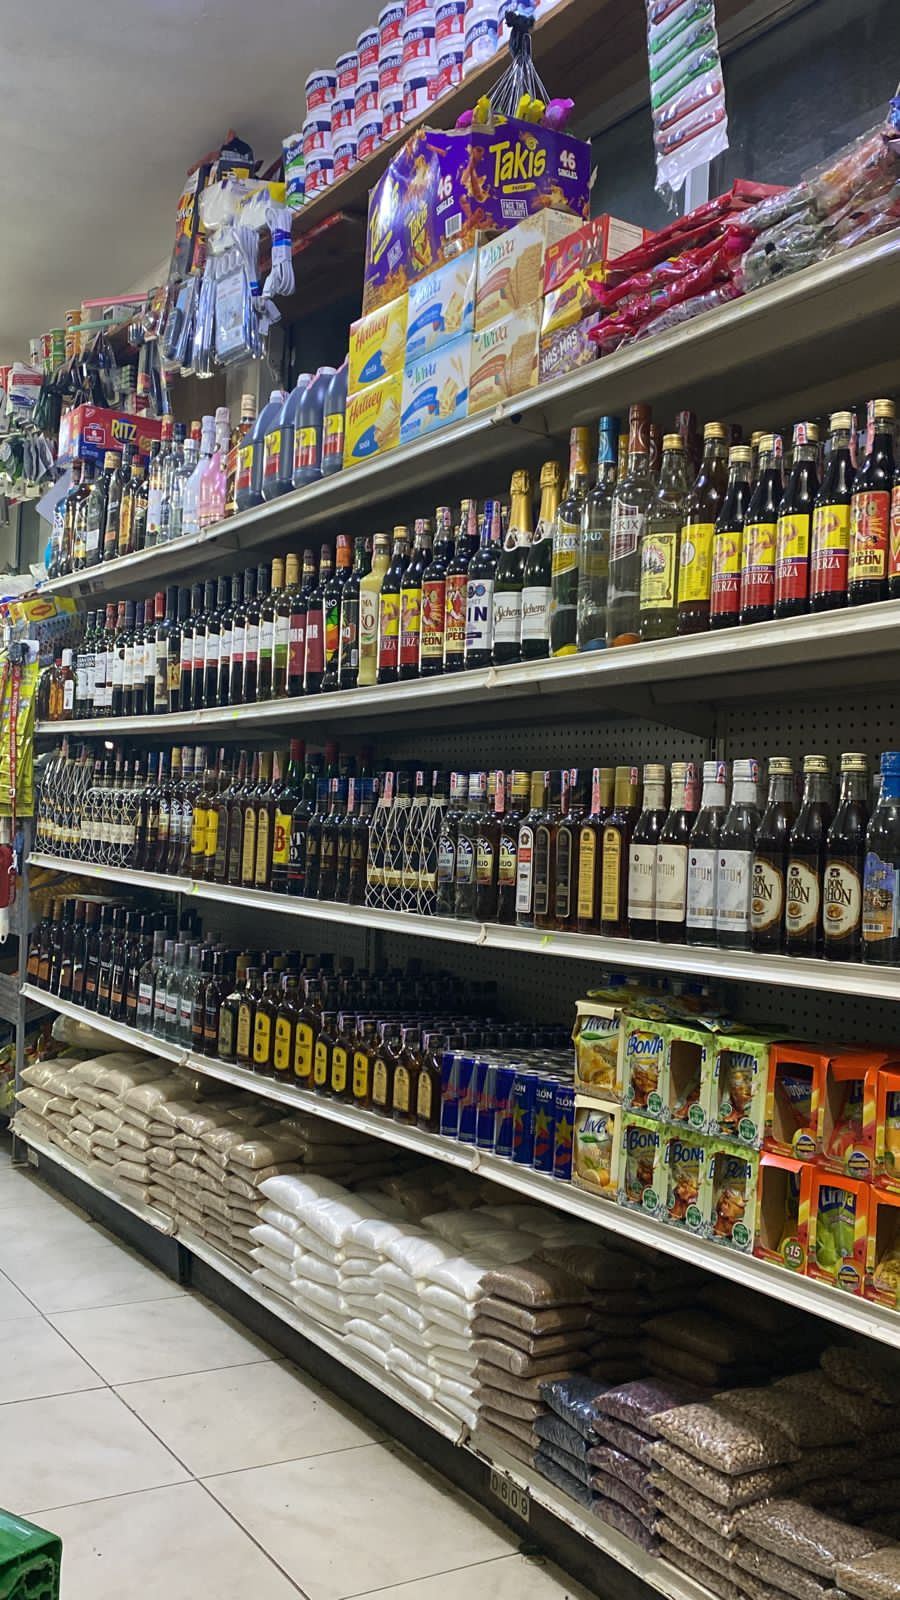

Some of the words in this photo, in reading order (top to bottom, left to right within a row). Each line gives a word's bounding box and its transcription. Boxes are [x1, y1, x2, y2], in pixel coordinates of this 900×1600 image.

[489, 141, 546, 187] Takis
[560, 150, 576, 169] 46
[438, 174, 453, 200] 46
[111, 419, 137, 441] RITZ
[492, 1473, 528, 1516] 0609
